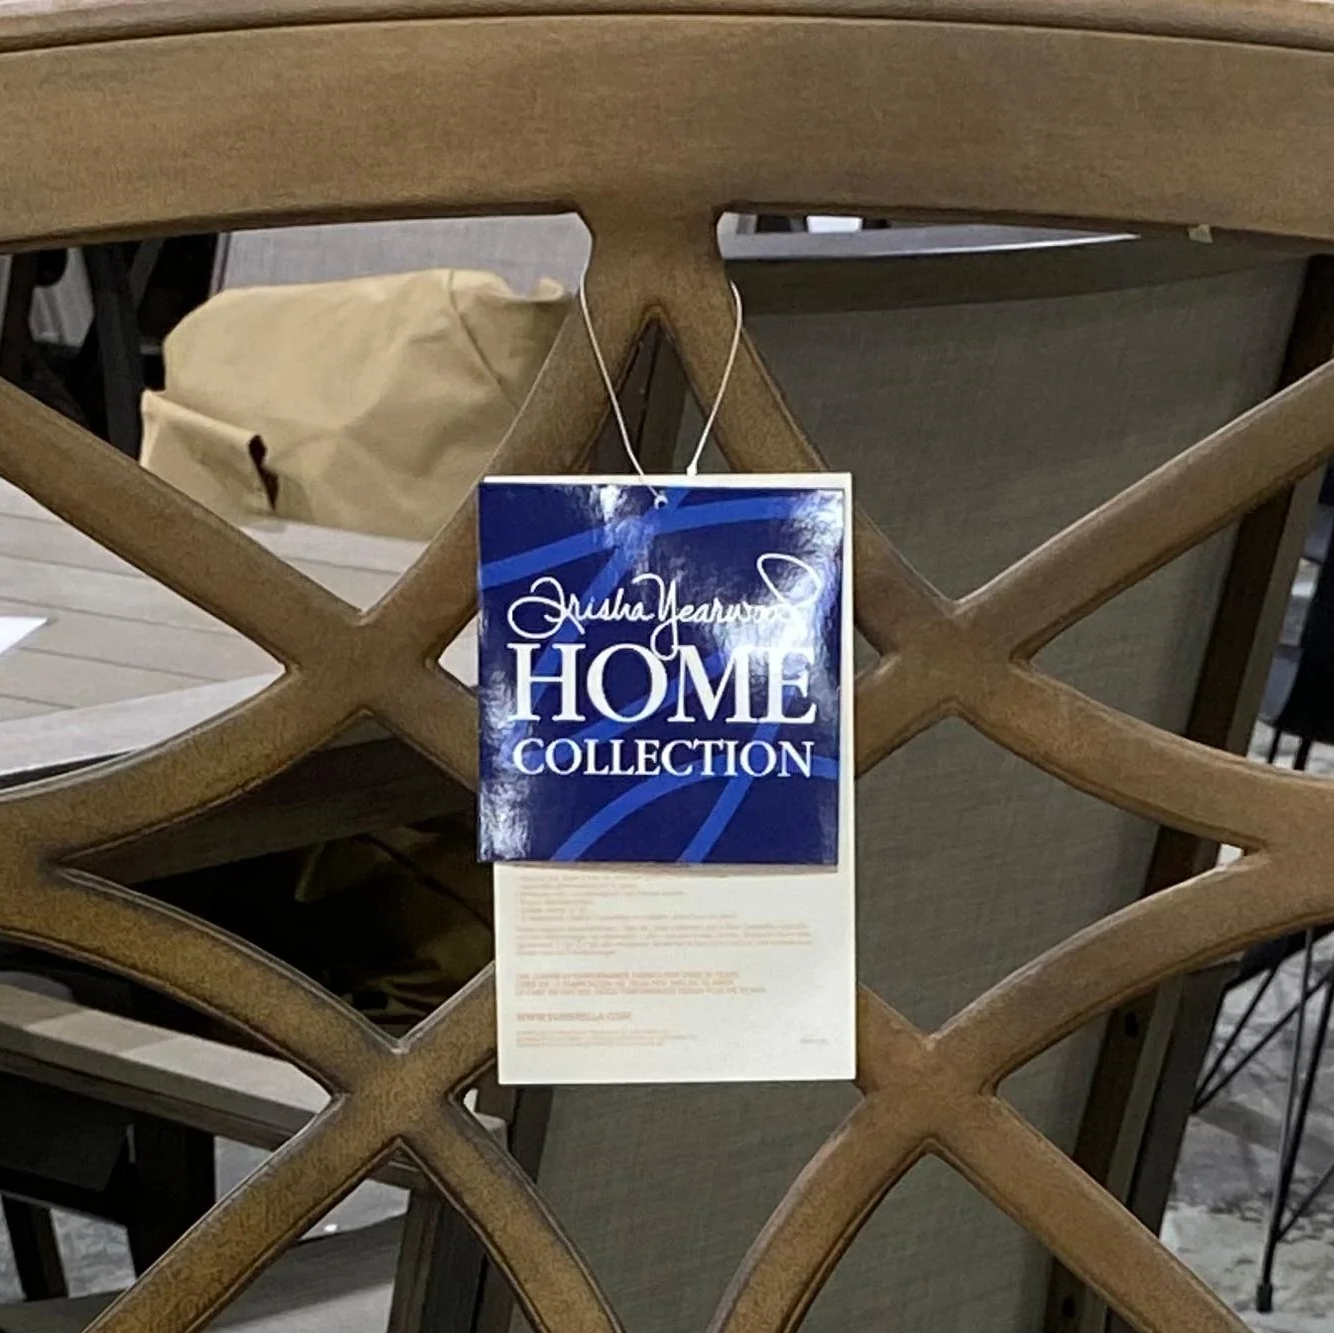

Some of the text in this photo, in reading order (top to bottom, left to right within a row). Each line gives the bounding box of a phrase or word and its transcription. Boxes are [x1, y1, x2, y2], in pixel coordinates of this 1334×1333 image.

[507, 576, 655, 639] Trisha
[507, 642, 816, 724] HOME
[512, 738, 815, 778] COLLECTION
